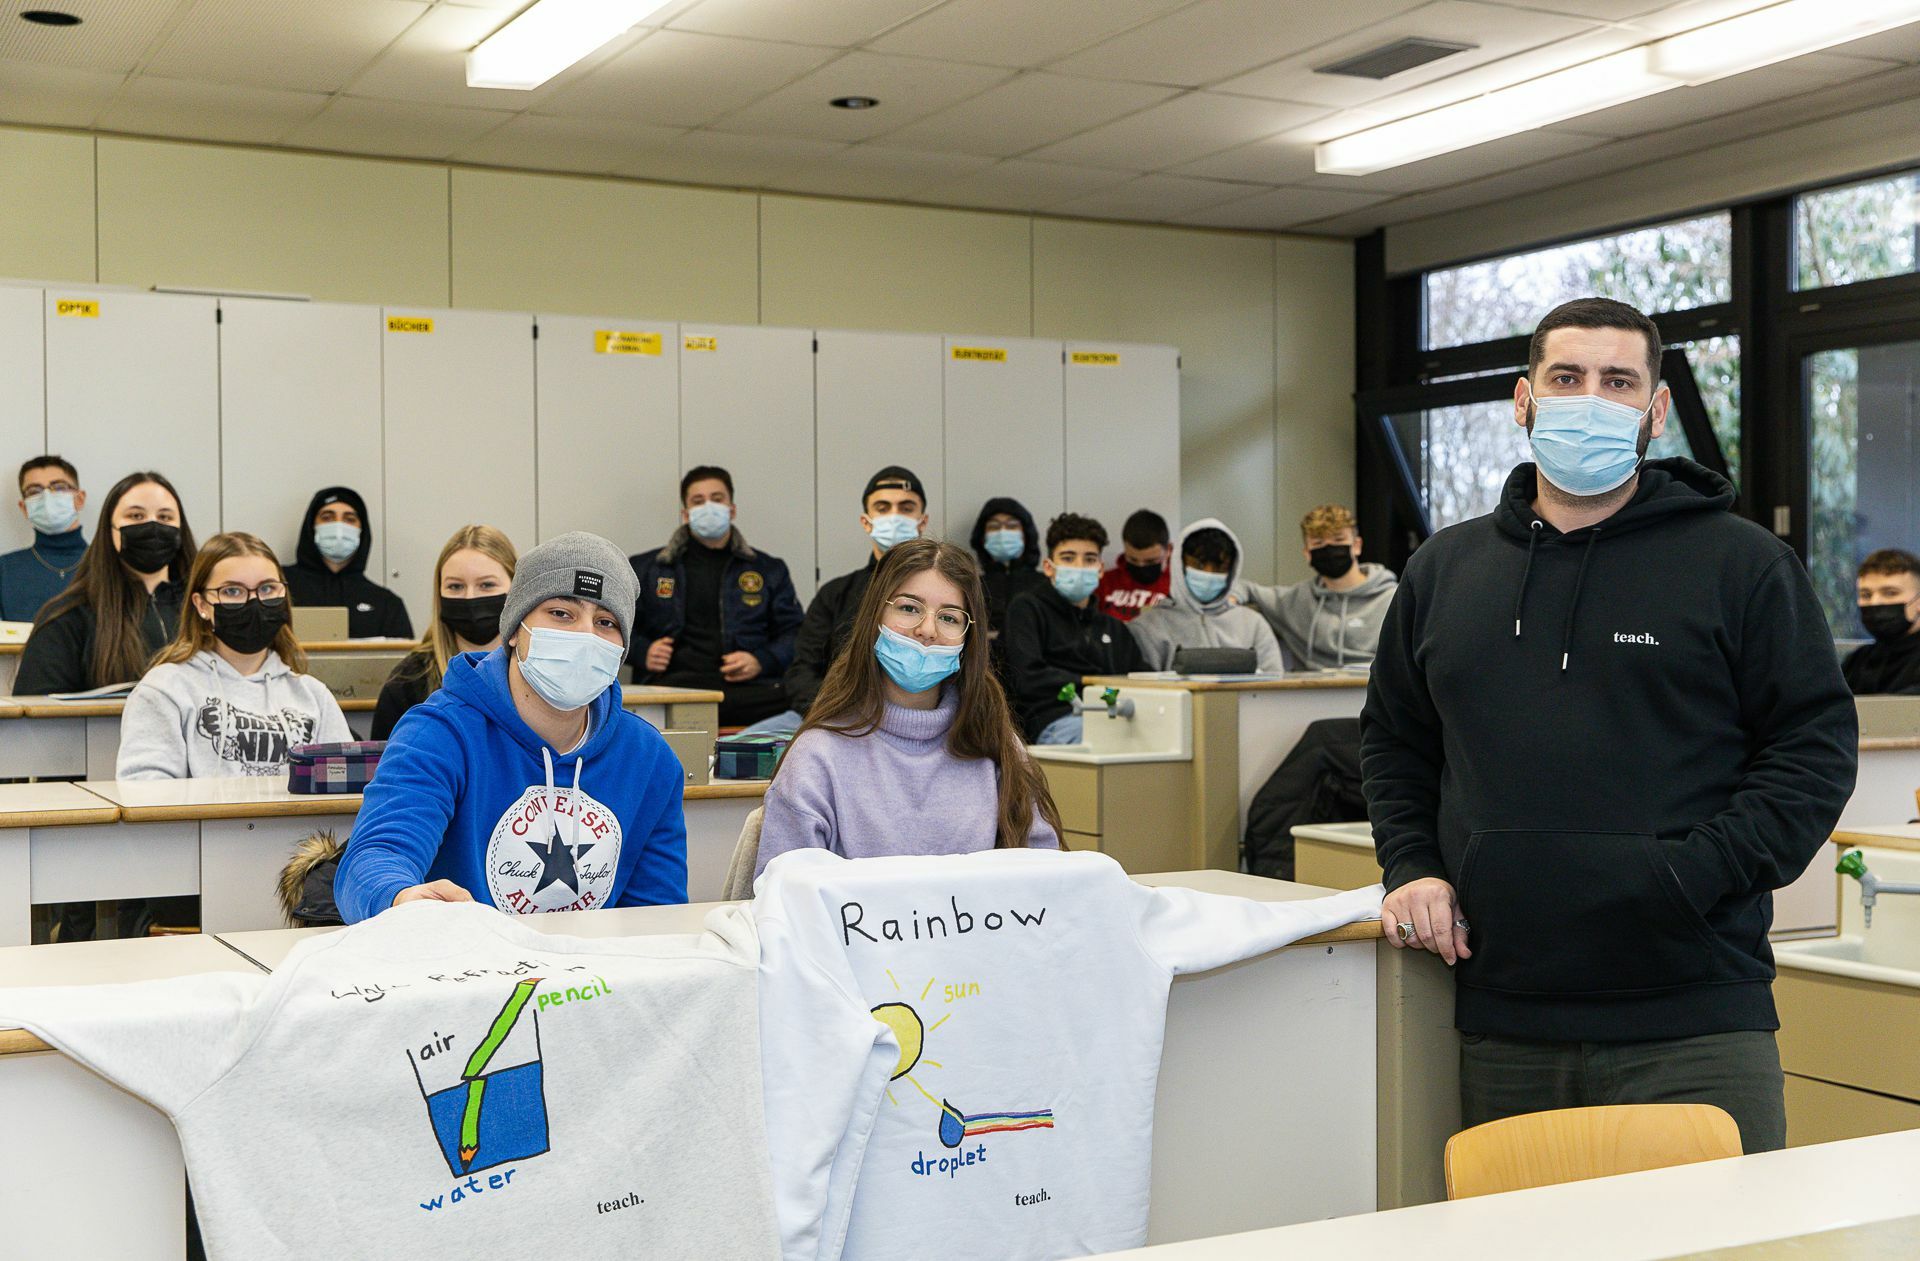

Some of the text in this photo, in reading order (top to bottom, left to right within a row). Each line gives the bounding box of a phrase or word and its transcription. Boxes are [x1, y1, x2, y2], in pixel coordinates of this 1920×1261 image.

[1105, 590, 1152, 608] JUST
[1613, 631, 1660, 646] teach.
[498, 860, 612, 885] Chuck Taylor
[546, 890, 597, 913] AR
[840, 895, 1047, 947] Rainbow
[537, 974, 612, 1013] pencil
[943, 980, 981, 1004] sun
[420, 1031, 456, 1061] air
[911, 1143, 987, 1179] droplet
[420, 1168, 517, 1212] water
[1015, 1187, 1052, 1206] teach.
[597, 1191, 646, 1215] teach.
